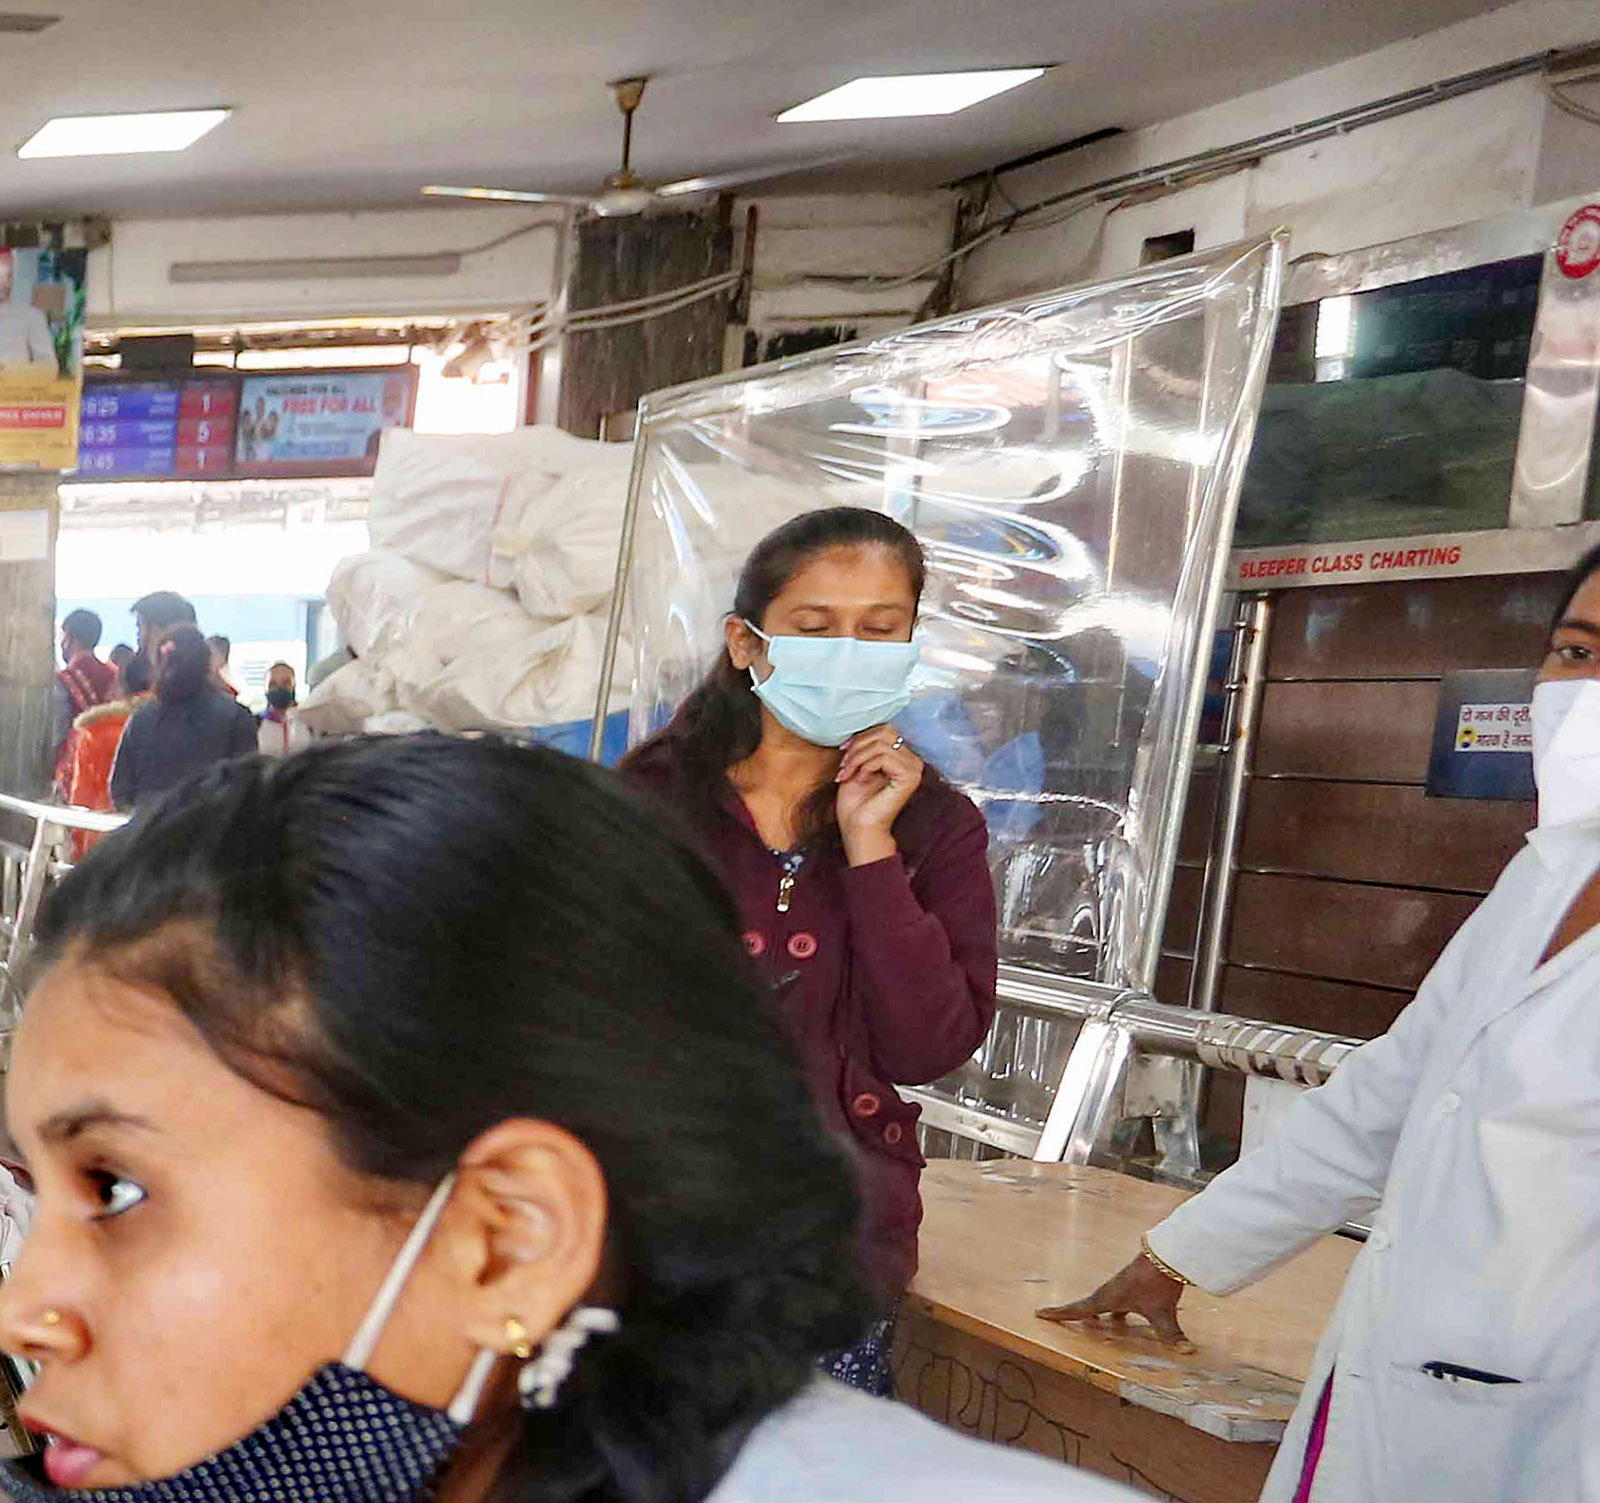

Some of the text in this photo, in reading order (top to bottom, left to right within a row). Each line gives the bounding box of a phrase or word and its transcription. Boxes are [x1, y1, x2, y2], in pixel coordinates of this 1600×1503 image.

[320, 396, 349, 414] FOR
[353, 395, 377, 413] ALL
[1239, 546, 1463, 578] SLEEPER CLASS CHARTING
